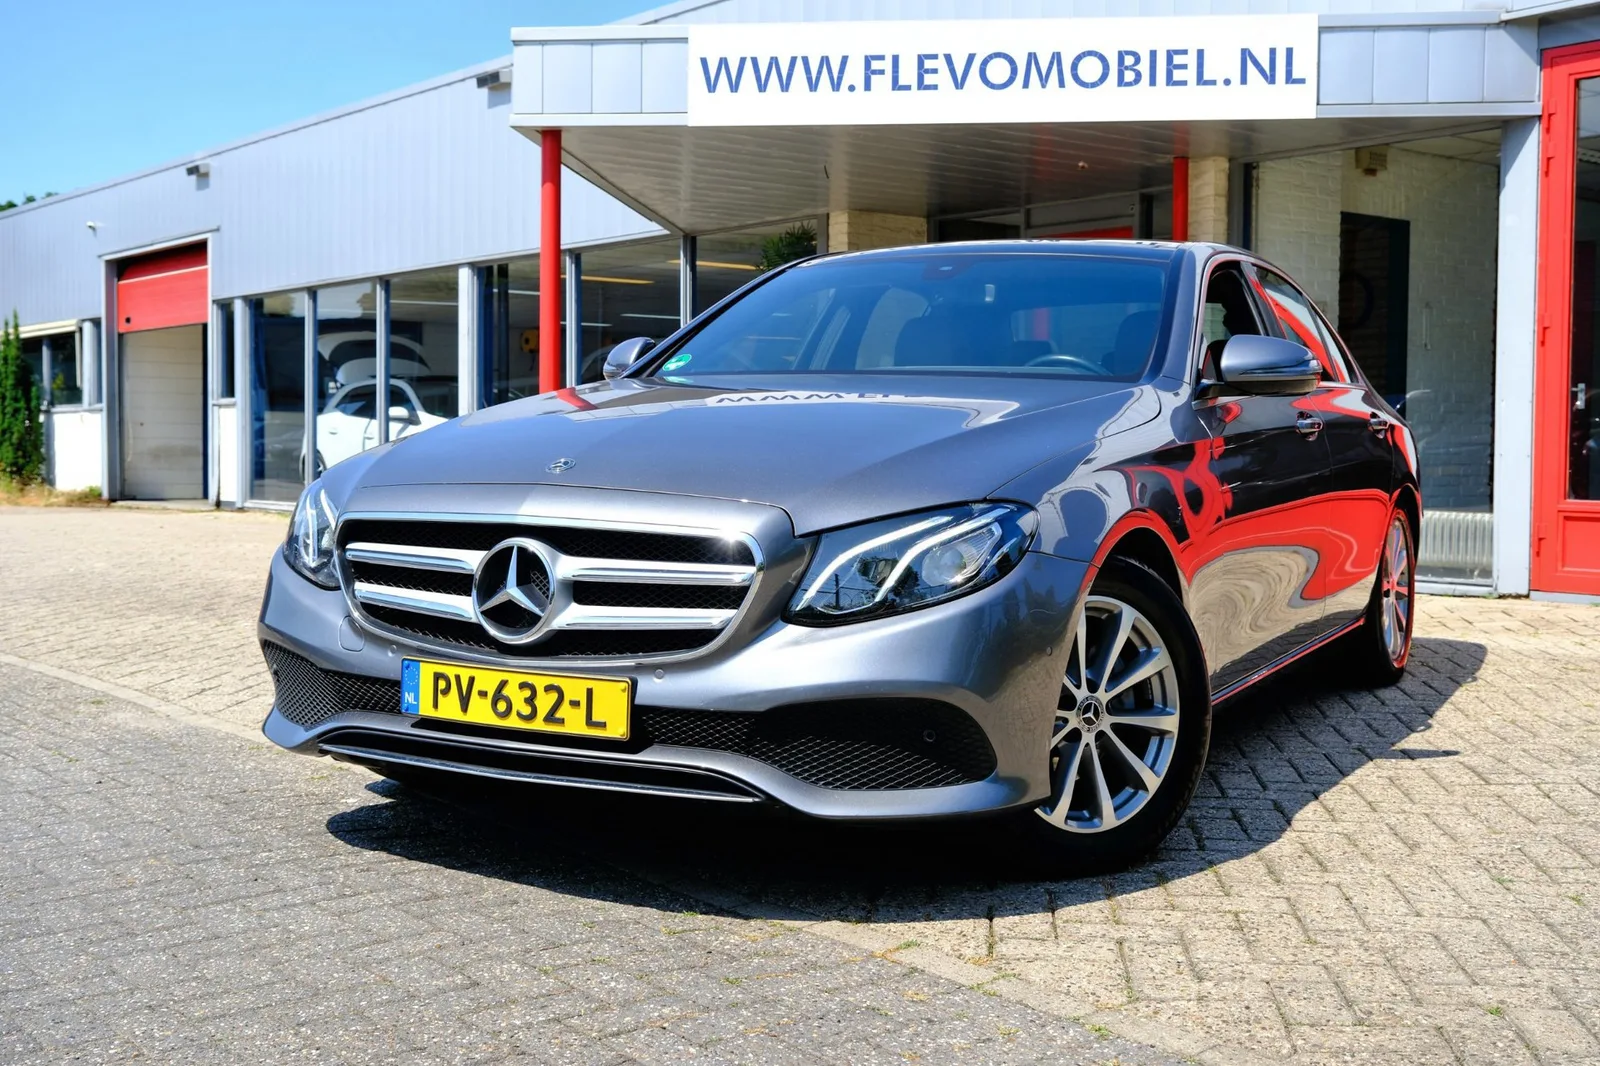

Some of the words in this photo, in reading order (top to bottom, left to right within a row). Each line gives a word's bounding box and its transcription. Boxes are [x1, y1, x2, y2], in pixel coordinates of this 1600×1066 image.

[700, 47, 1306, 94] WWW.FLEVOMOBIEL.NL
[404, 692, 417, 705] NL
[431, 671, 607, 728] PV-632-L
